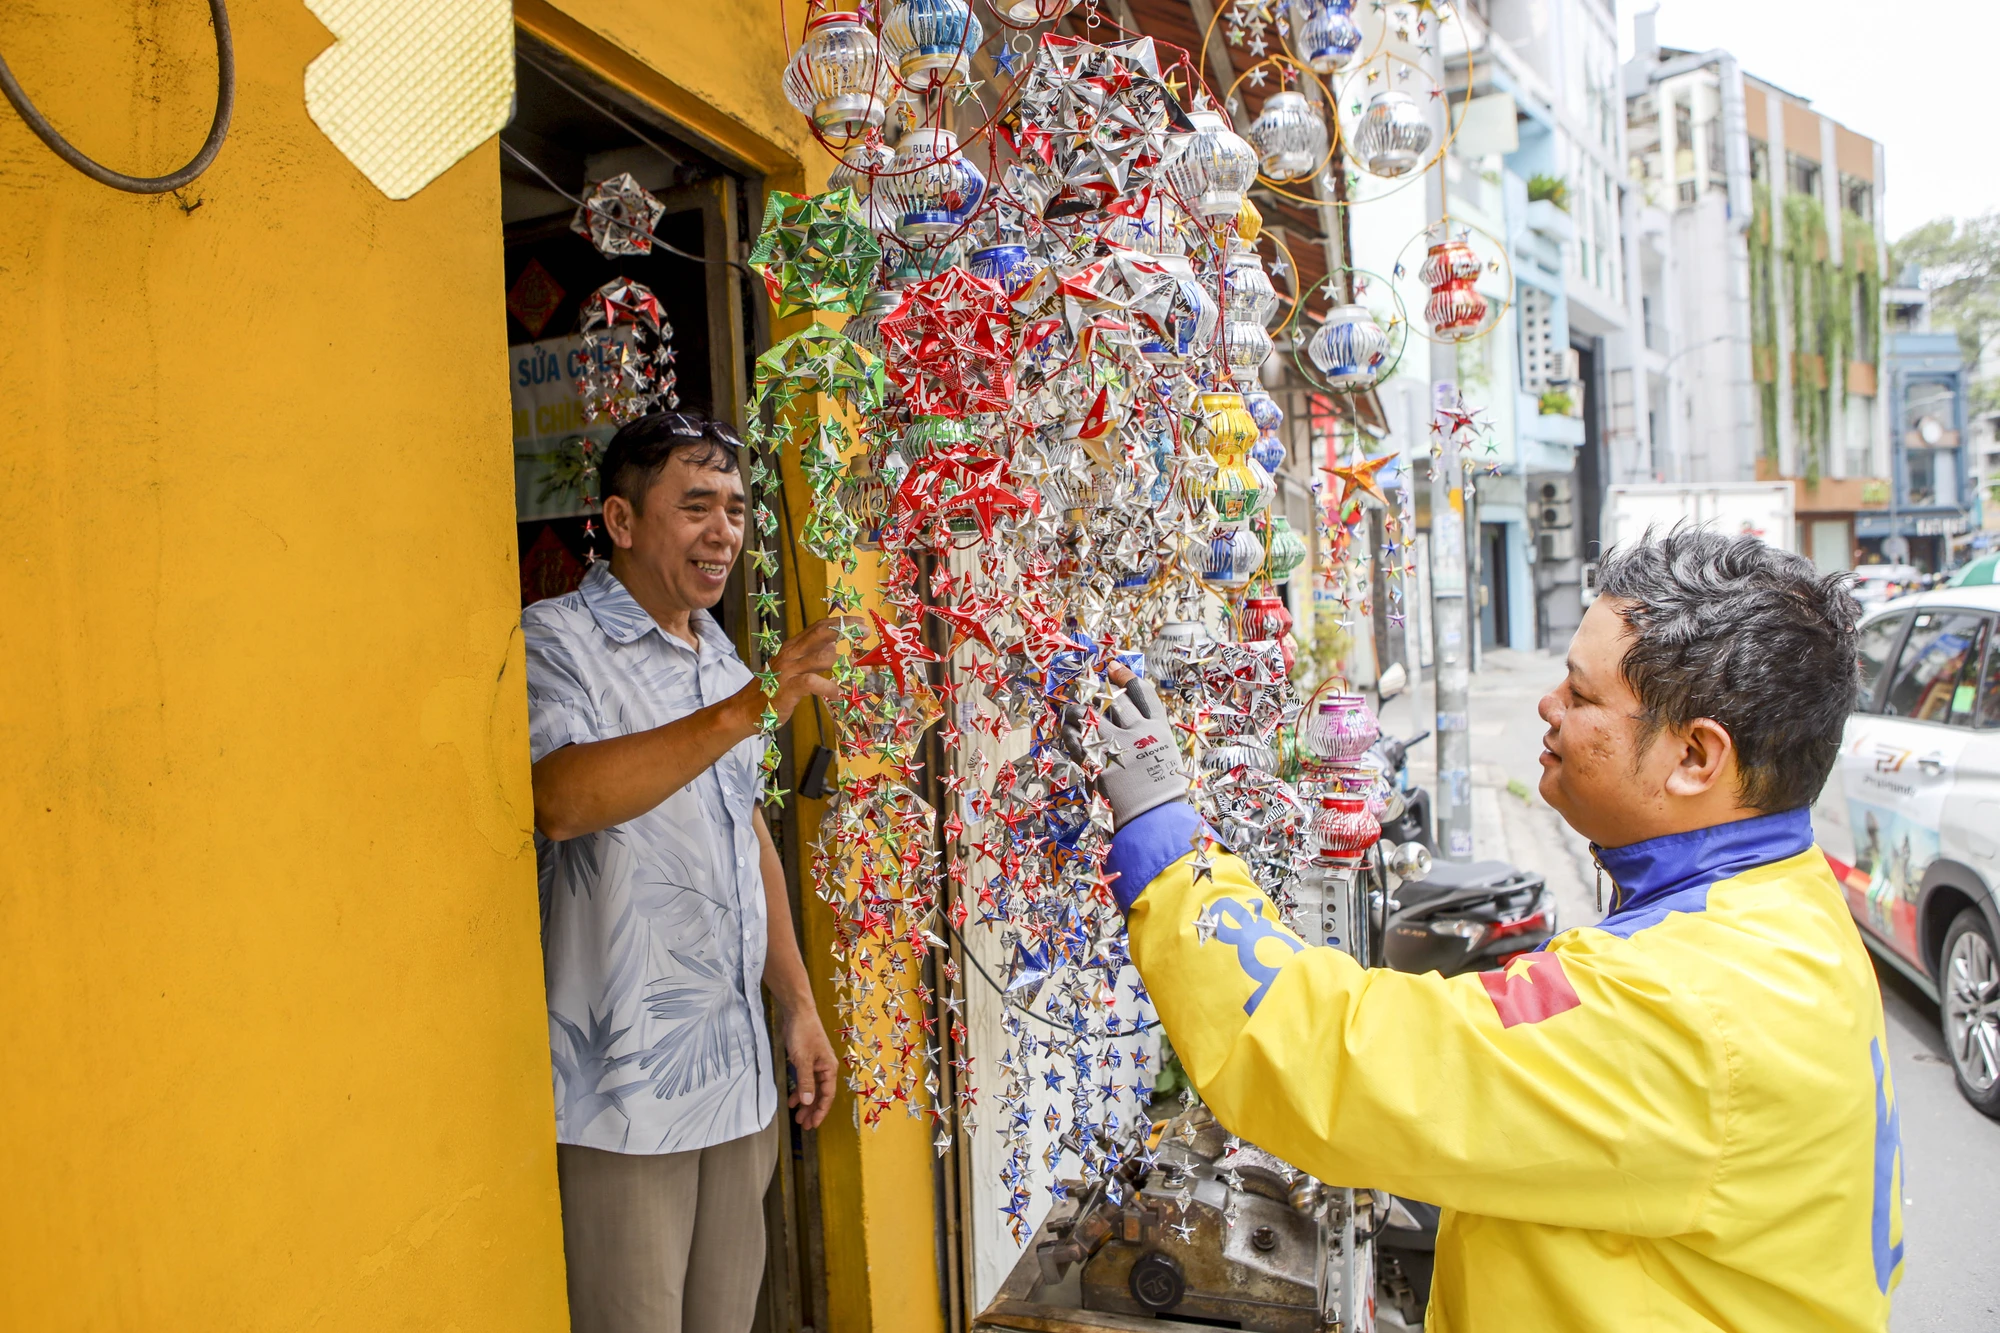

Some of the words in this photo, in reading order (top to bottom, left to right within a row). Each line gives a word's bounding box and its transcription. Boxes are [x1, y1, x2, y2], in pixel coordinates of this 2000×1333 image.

[518, 345, 561, 387] SỬA
[1133, 735, 1158, 749] 3M
[1136, 744, 1169, 760] Gloves
